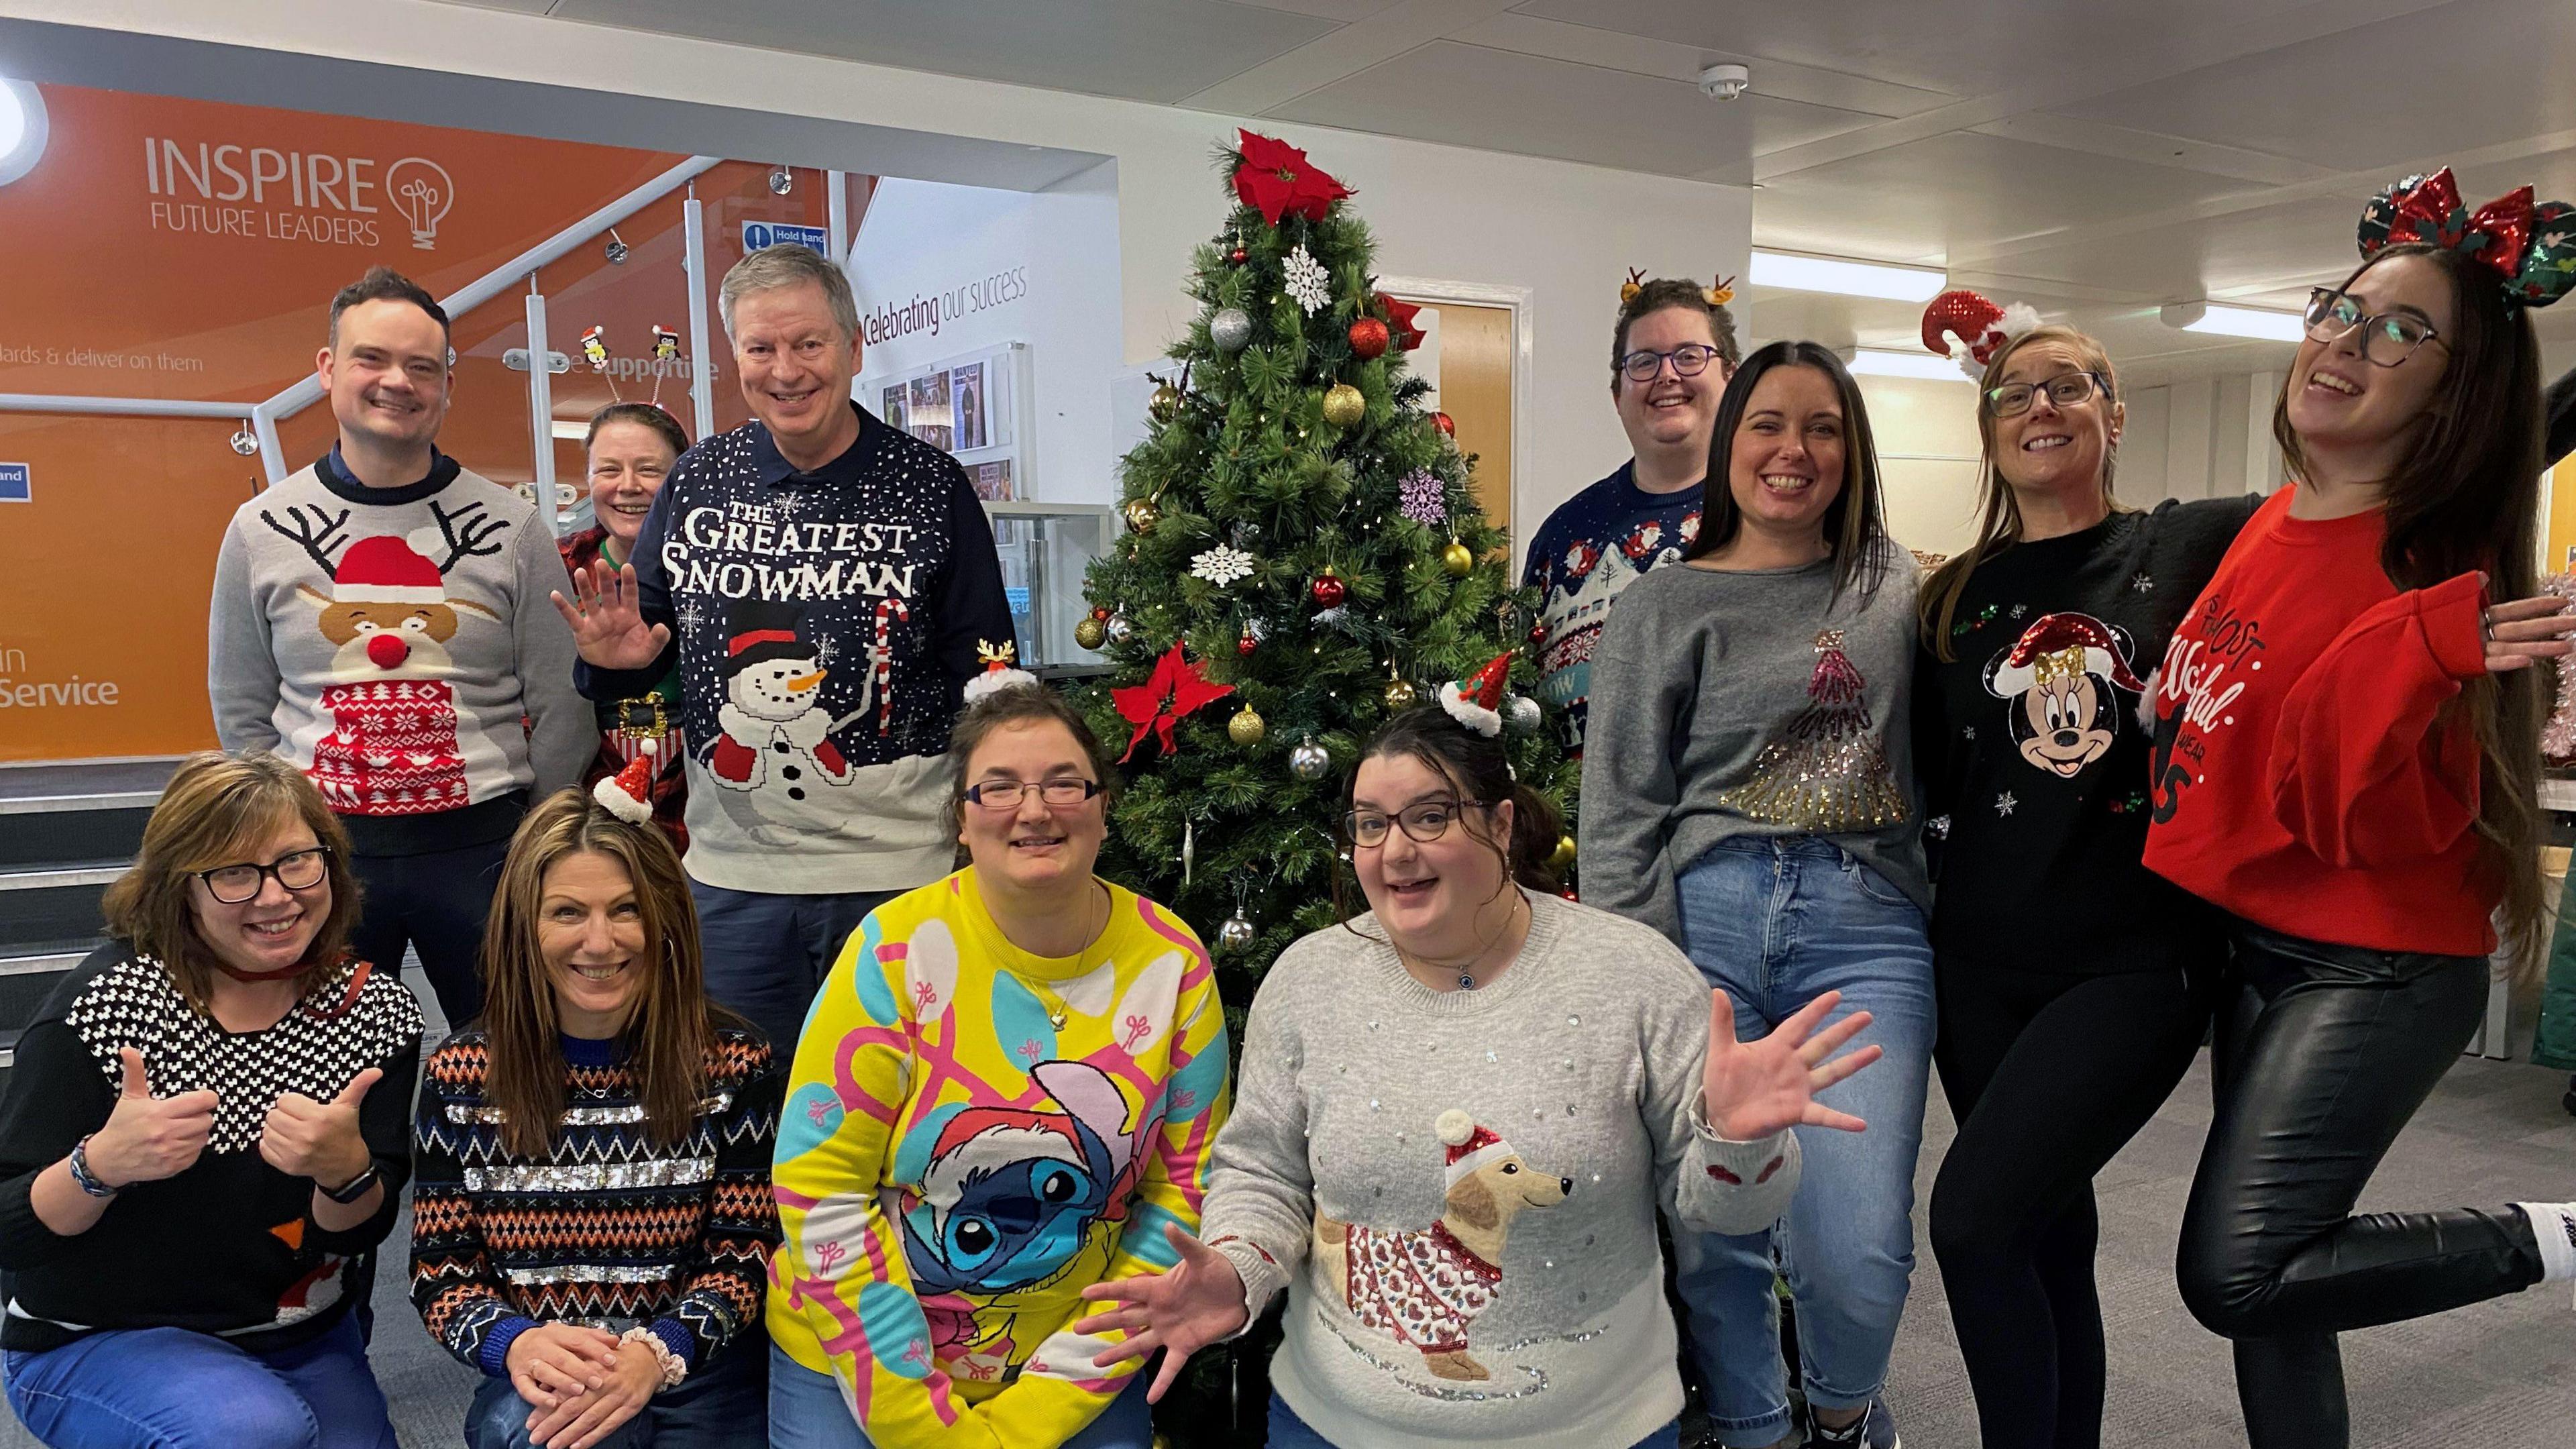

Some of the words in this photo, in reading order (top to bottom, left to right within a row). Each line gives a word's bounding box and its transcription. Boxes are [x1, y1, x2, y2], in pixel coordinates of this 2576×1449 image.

[146, 138, 378, 213] INSPIRE
[151, 202, 257, 237] FUTURE
[266, 212, 380, 247] LEADERS
[777, 229, 799, 240] Hold
[863, 293, 939, 346] Celebrating
[943, 286, 966, 321] our
[971, 266, 1027, 313] success
[0, 343, 40, 364] ards
[46, 347, 59, 364] &
[66, 347, 124, 368] deliver
[129, 354, 152, 369] on
[158, 352, 203, 372] them
[591, 356, 719, 382] upportie
[684, 506, 912, 556] GREATEST
[729, 500, 773, 524] THE
[661, 541, 915, 602] SNOWMAN
[0, 674, 119, 708] Service
